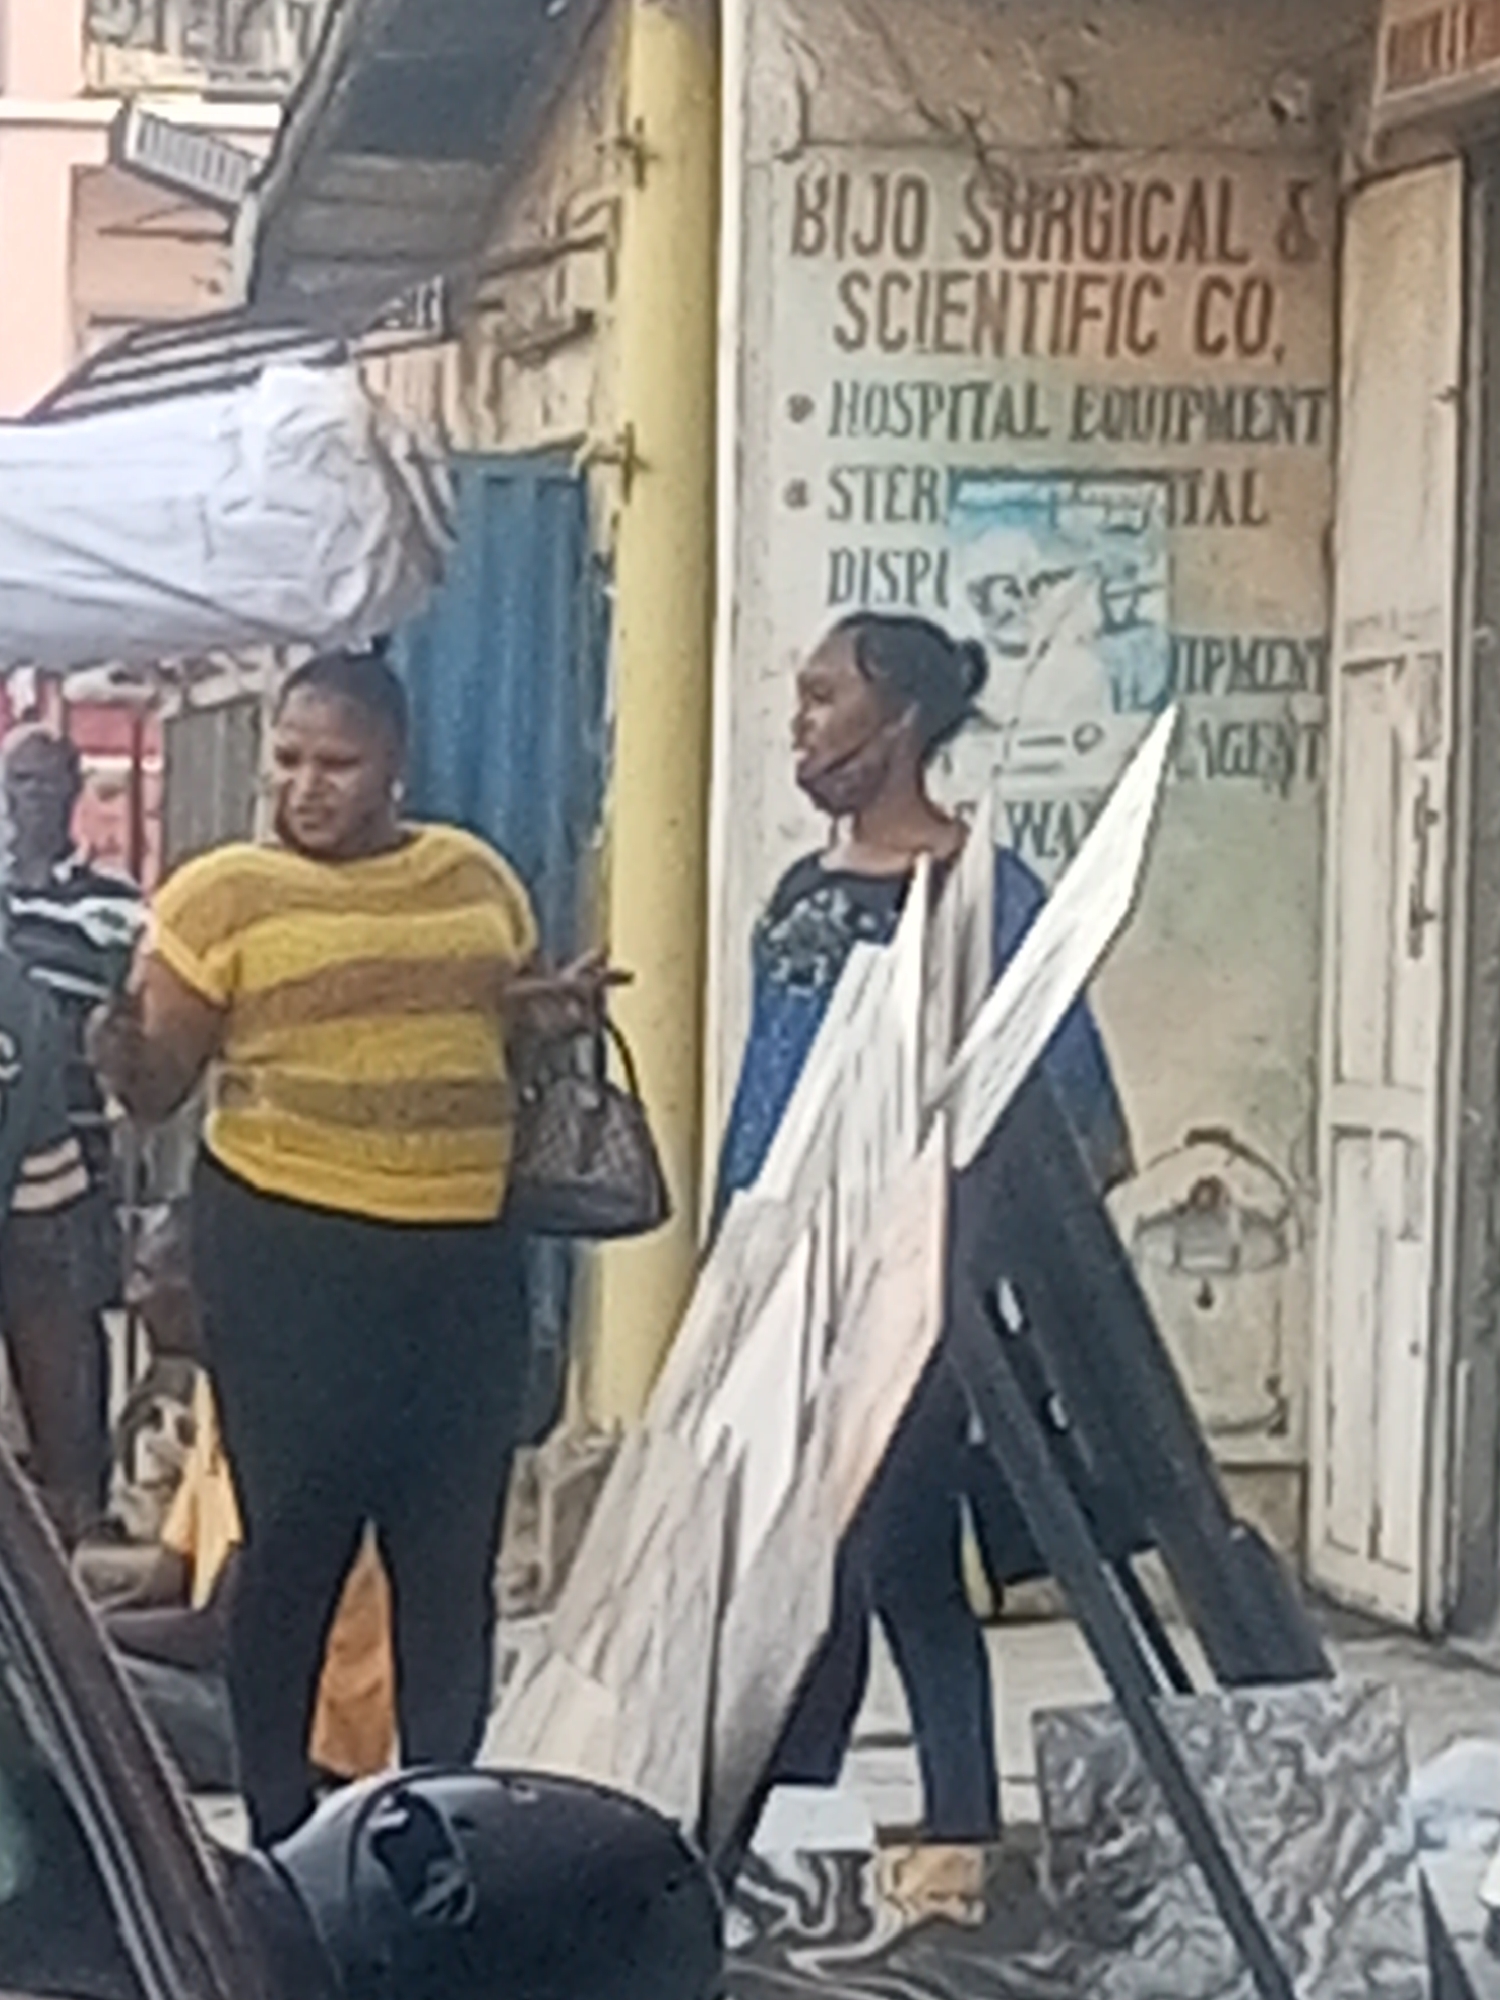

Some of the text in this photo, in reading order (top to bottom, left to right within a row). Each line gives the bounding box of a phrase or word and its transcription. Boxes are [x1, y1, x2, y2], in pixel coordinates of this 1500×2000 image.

[792, 171, 1320, 267] BIJO SURGICAL &
[833, 268, 1287, 365] SCIENTIFIC CO.
[827, 379, 1329, 446] HOSPITAL EQUIPMENT
[827, 463, 948, 527] STER
